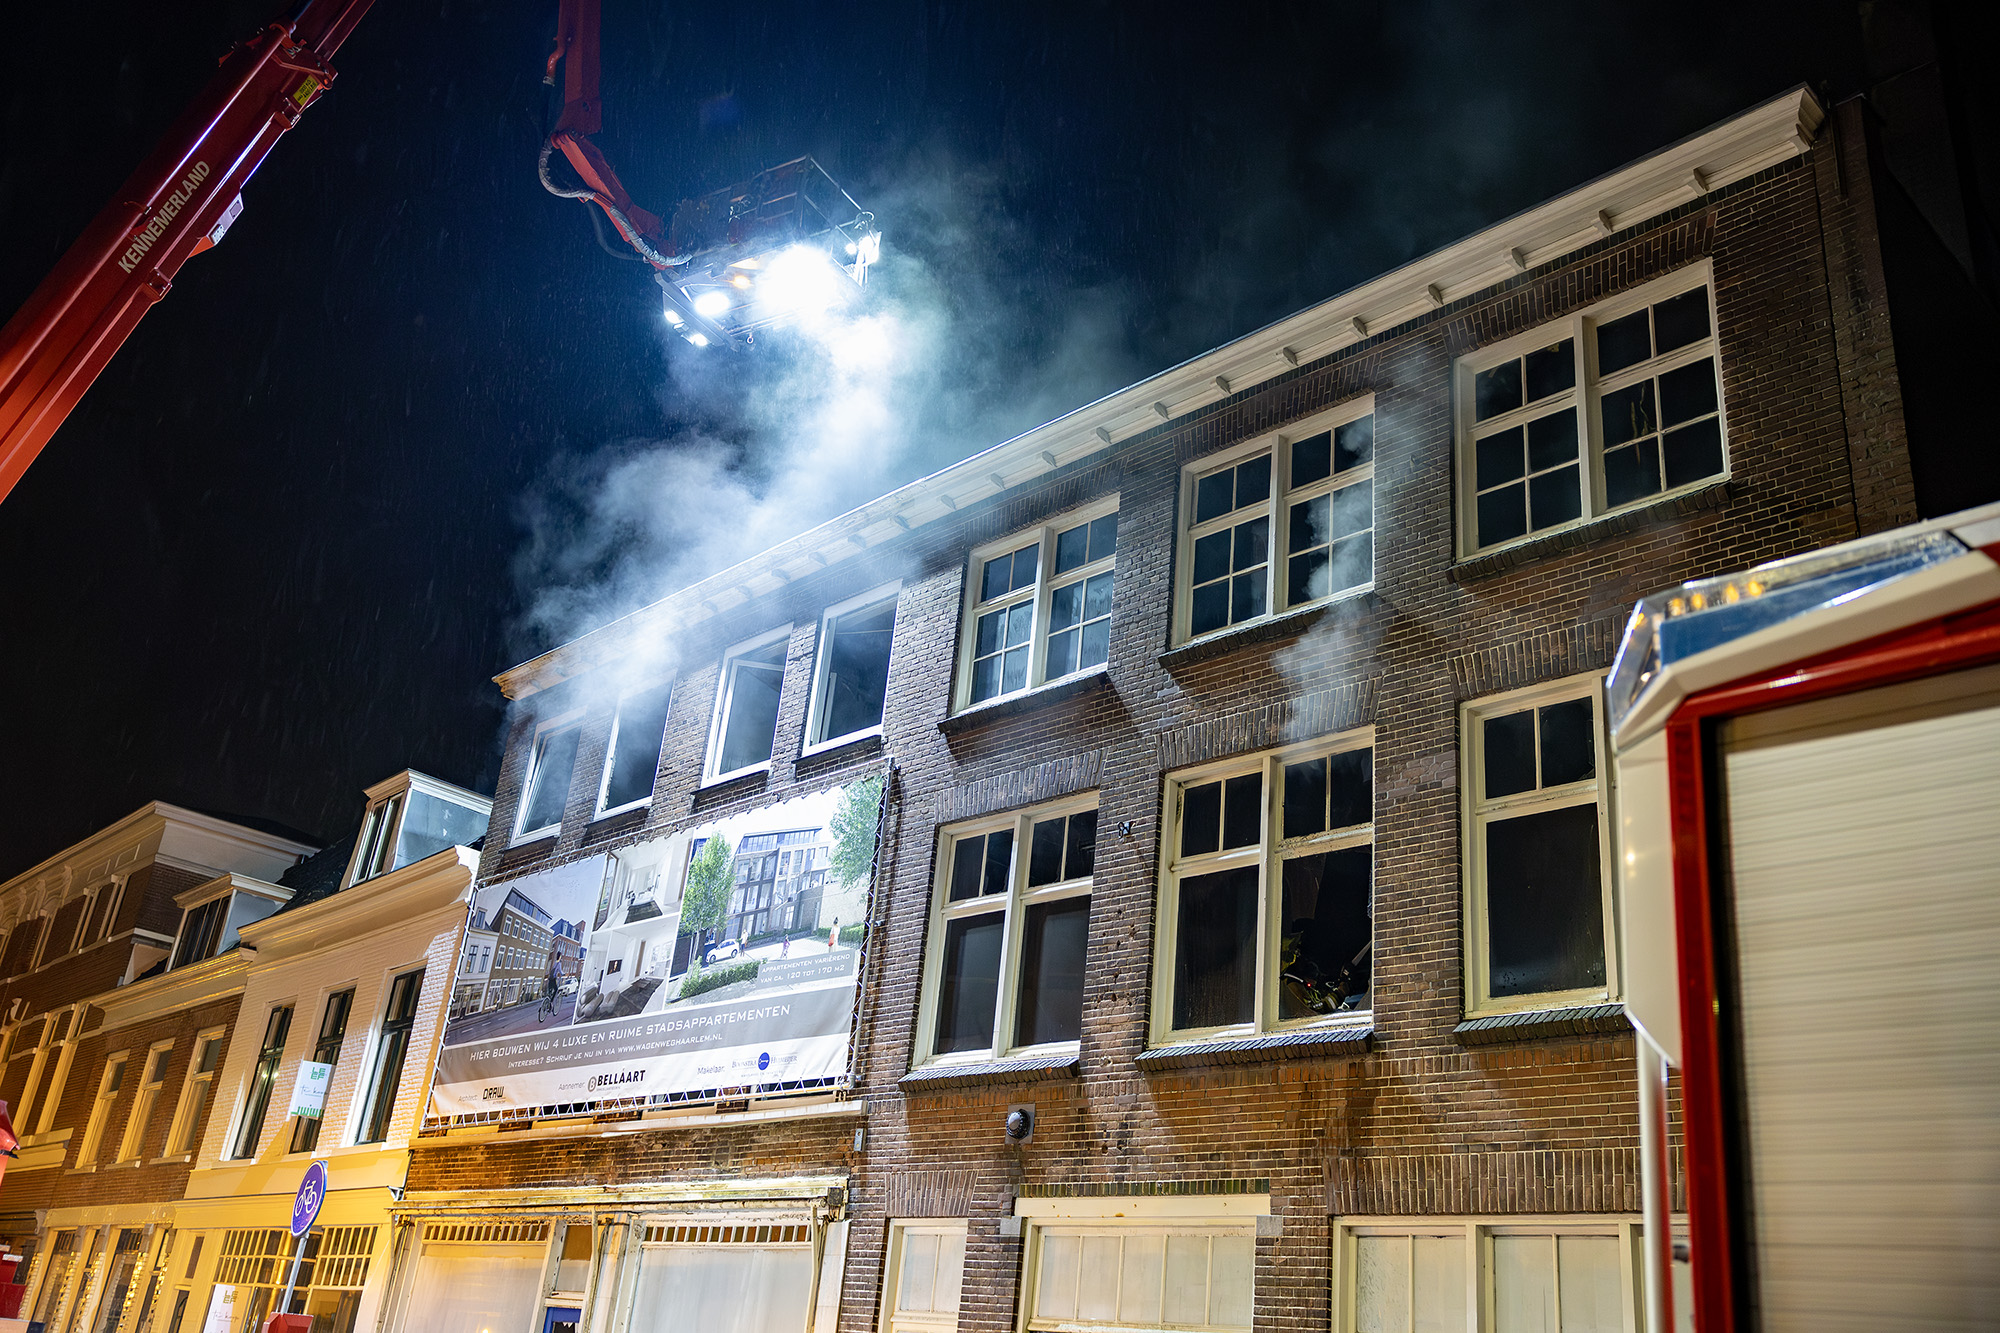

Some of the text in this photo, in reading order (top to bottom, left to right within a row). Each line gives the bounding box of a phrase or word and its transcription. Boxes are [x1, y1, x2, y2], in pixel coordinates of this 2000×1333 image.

[118, 161, 210, 274] KENNEMERLAND
[761, 960, 813, 973] APPARTEMENTEN
[787, 971, 801, 979] 120
[803, 969, 815, 977] TOT
[818, 966, 832, 974] 170
[834, 964, 845, 972] M2
[470, 1004, 791, 1061] HIER BOUWEN WIJ 4 LUXE EN RUIME STADSAPPARTEMENTEN
[508, 1055, 544, 1069] INTERESSE?
[545, 1053, 573, 1064] SCHRIJF
[573, 1052, 582, 1060] JE
[583, 1051, 594, 1059] NU
[604, 1048, 616, 1056] VIA
[482, 1085, 505, 1100] DRAW
